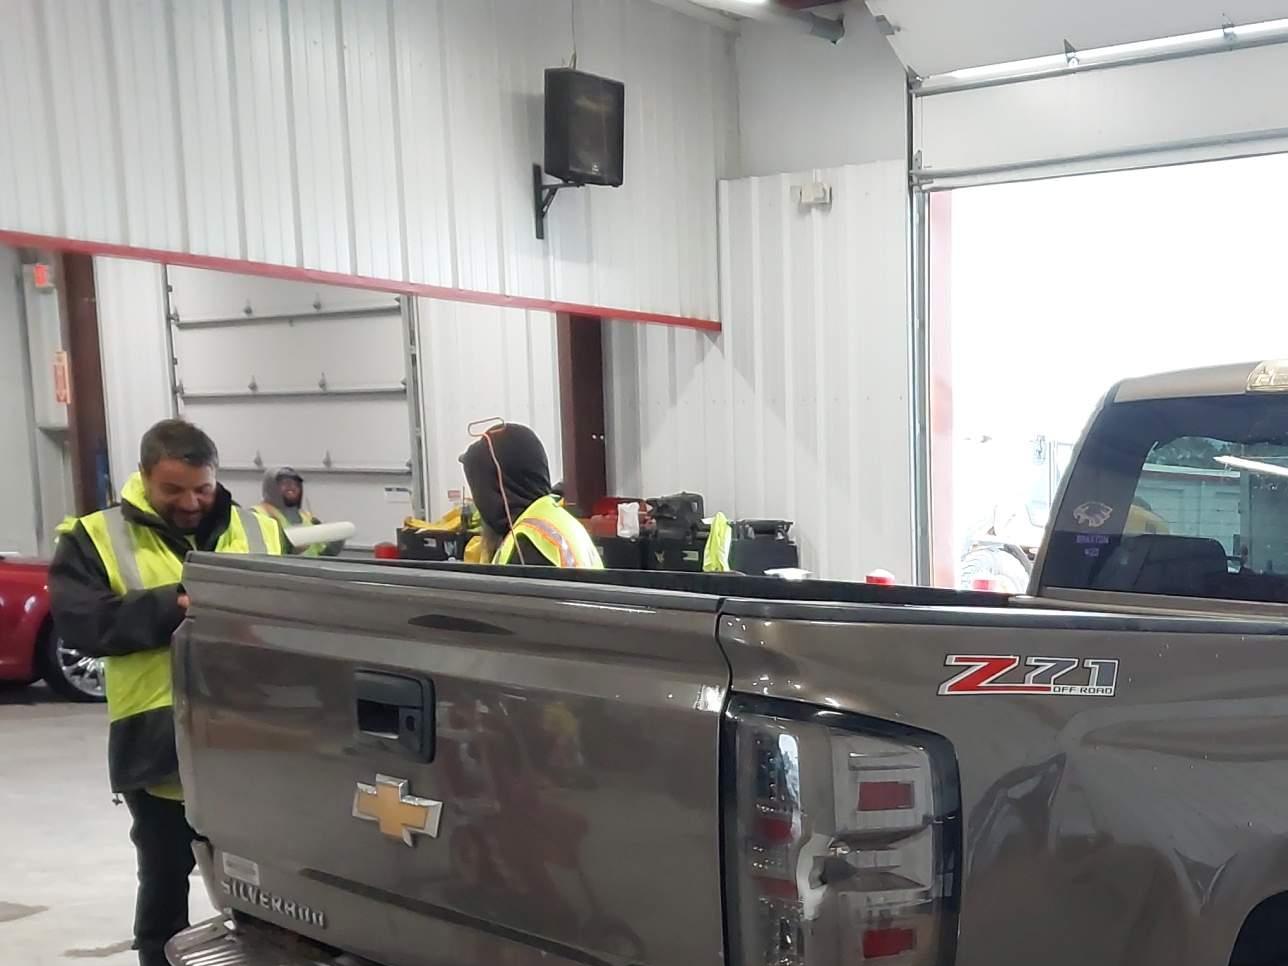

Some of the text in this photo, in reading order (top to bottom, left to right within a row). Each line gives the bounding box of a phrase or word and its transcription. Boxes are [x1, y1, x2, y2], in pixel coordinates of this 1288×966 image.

[937, 655, 1119, 695] Z71
[1053, 686, 1113, 695] OFF ROAD
